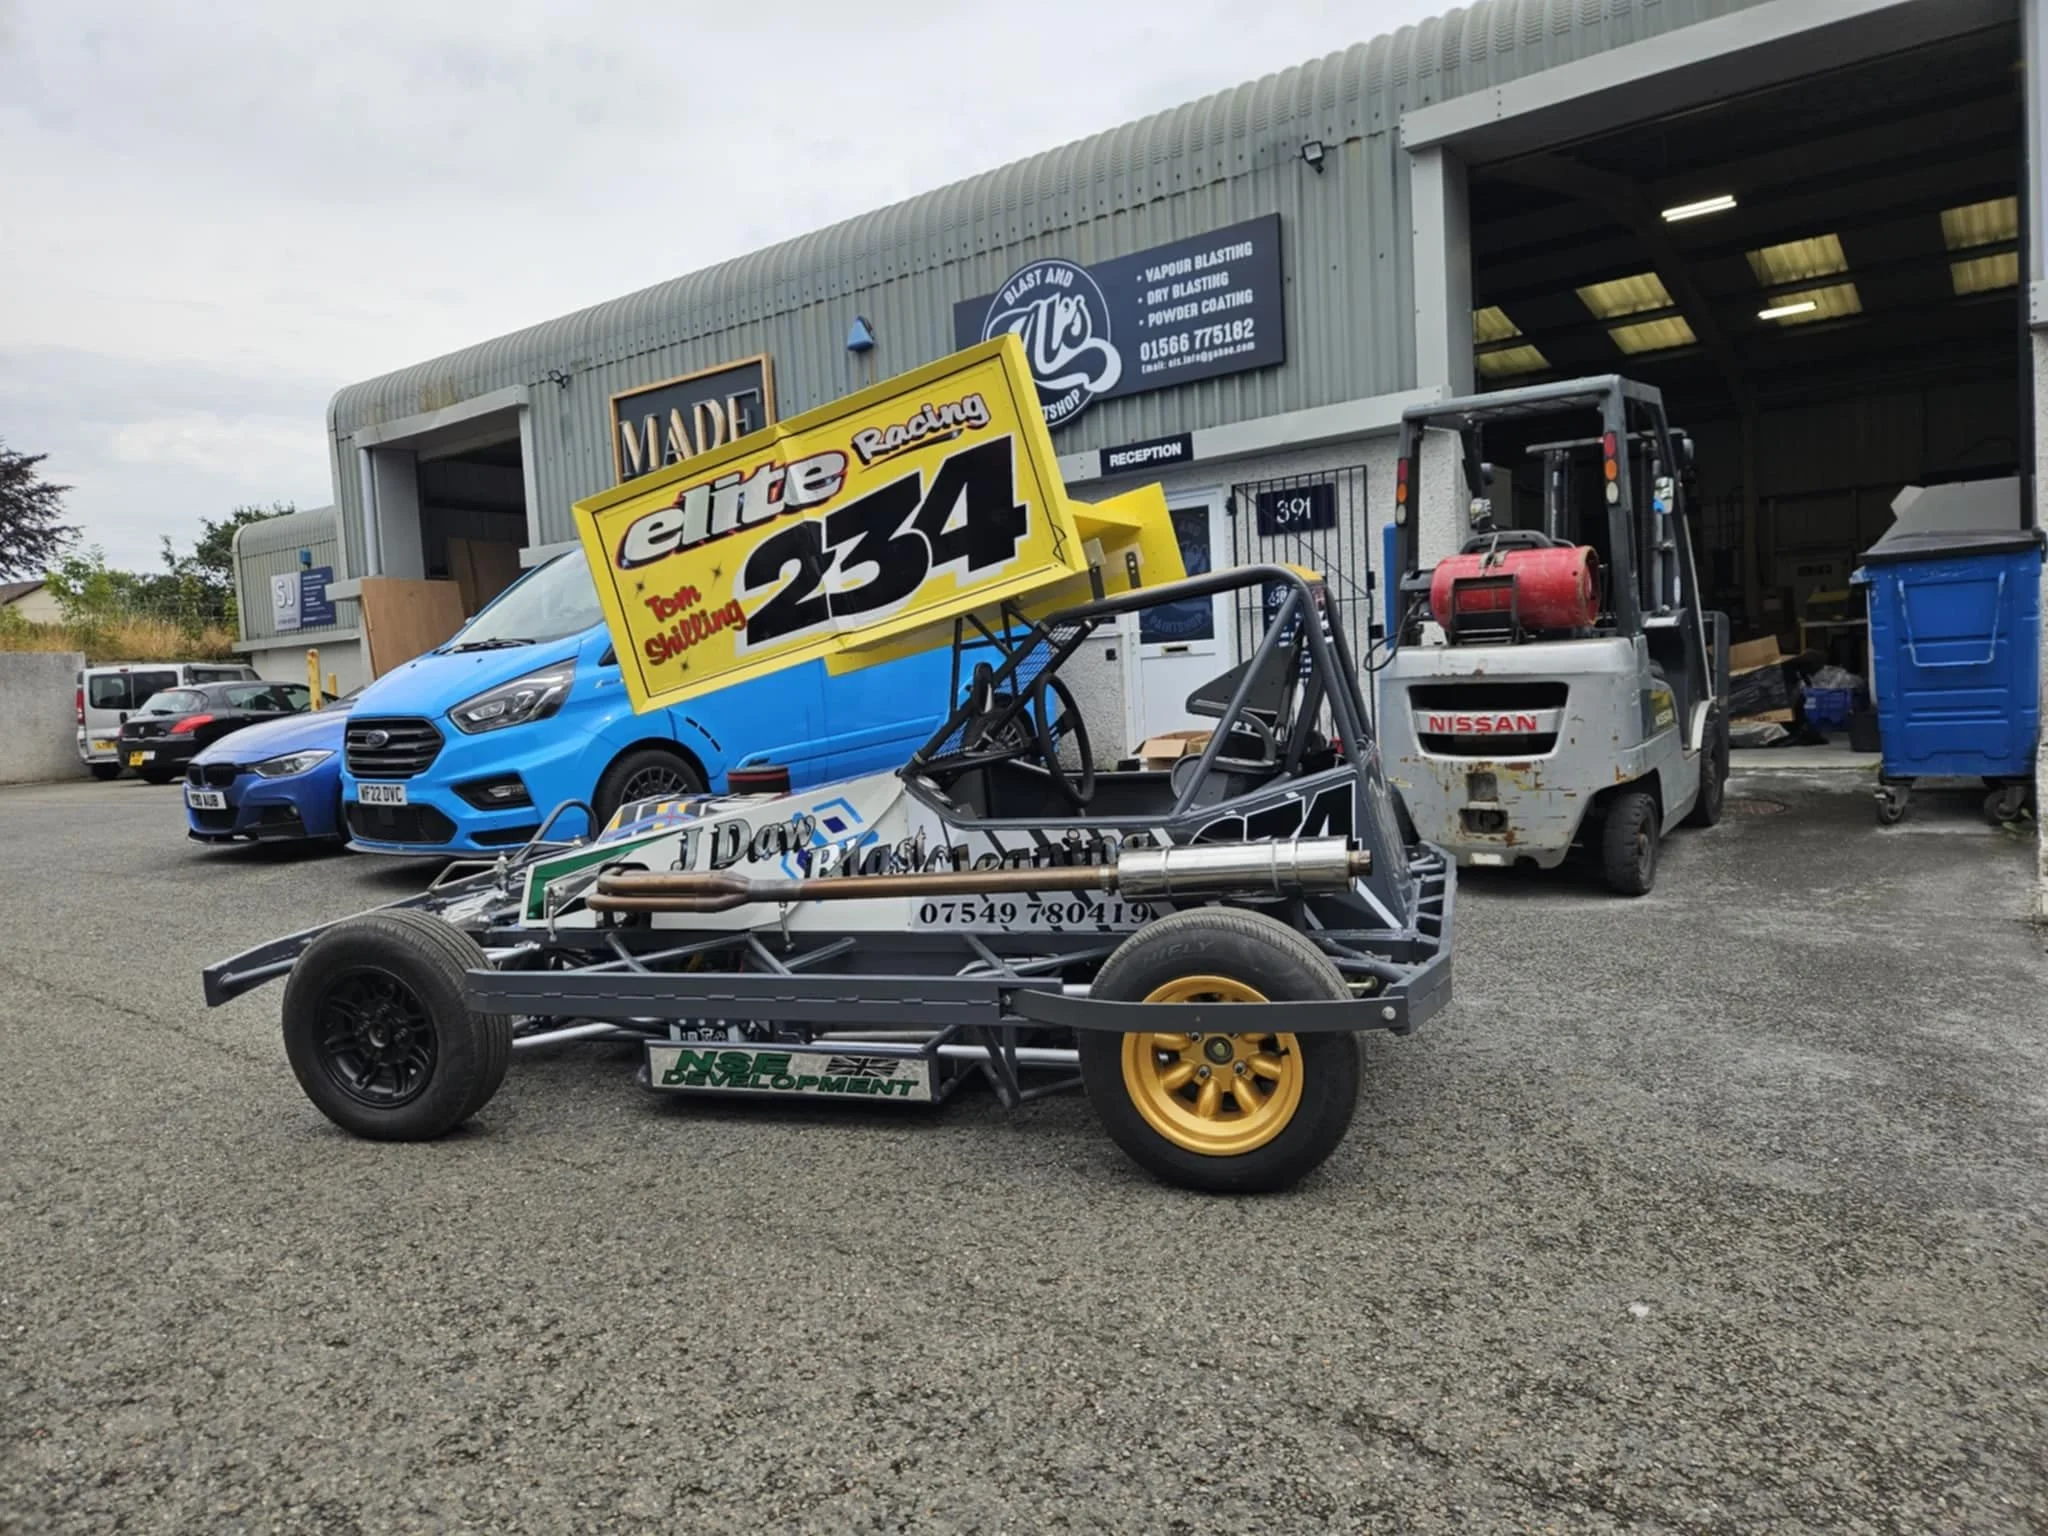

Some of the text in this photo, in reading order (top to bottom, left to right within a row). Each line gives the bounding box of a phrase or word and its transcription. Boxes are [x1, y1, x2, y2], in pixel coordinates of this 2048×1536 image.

[1145, 241, 1253, 282] VAPOUR BLASTING
[1003, 267, 1074, 306] BLAST AND
[1147, 271, 1229, 305] DRY BLASTING
[1147, 288, 1253, 328] POWDER COATING
[1139, 318, 1255, 361] 01566 775182
[1043, 388, 1080, 420] TSHOP
[619, 387, 761, 477] MADE
[1109, 441, 1182, 467] RECEPTION
[616, 393, 991, 568] elite Racing
[738, 433, 1029, 650] 234
[644, 585, 702, 622] Tom
[645, 598, 747, 666] Shilling
[1429, 715, 1537, 732] NISSAN
[670, 815, 816, 871] J Daw
[919, 902, 1151, 924] 07549 780419
[674, 1050, 793, 1075] NSE
[662, 1070, 919, 1096] DEVELOPMENT
